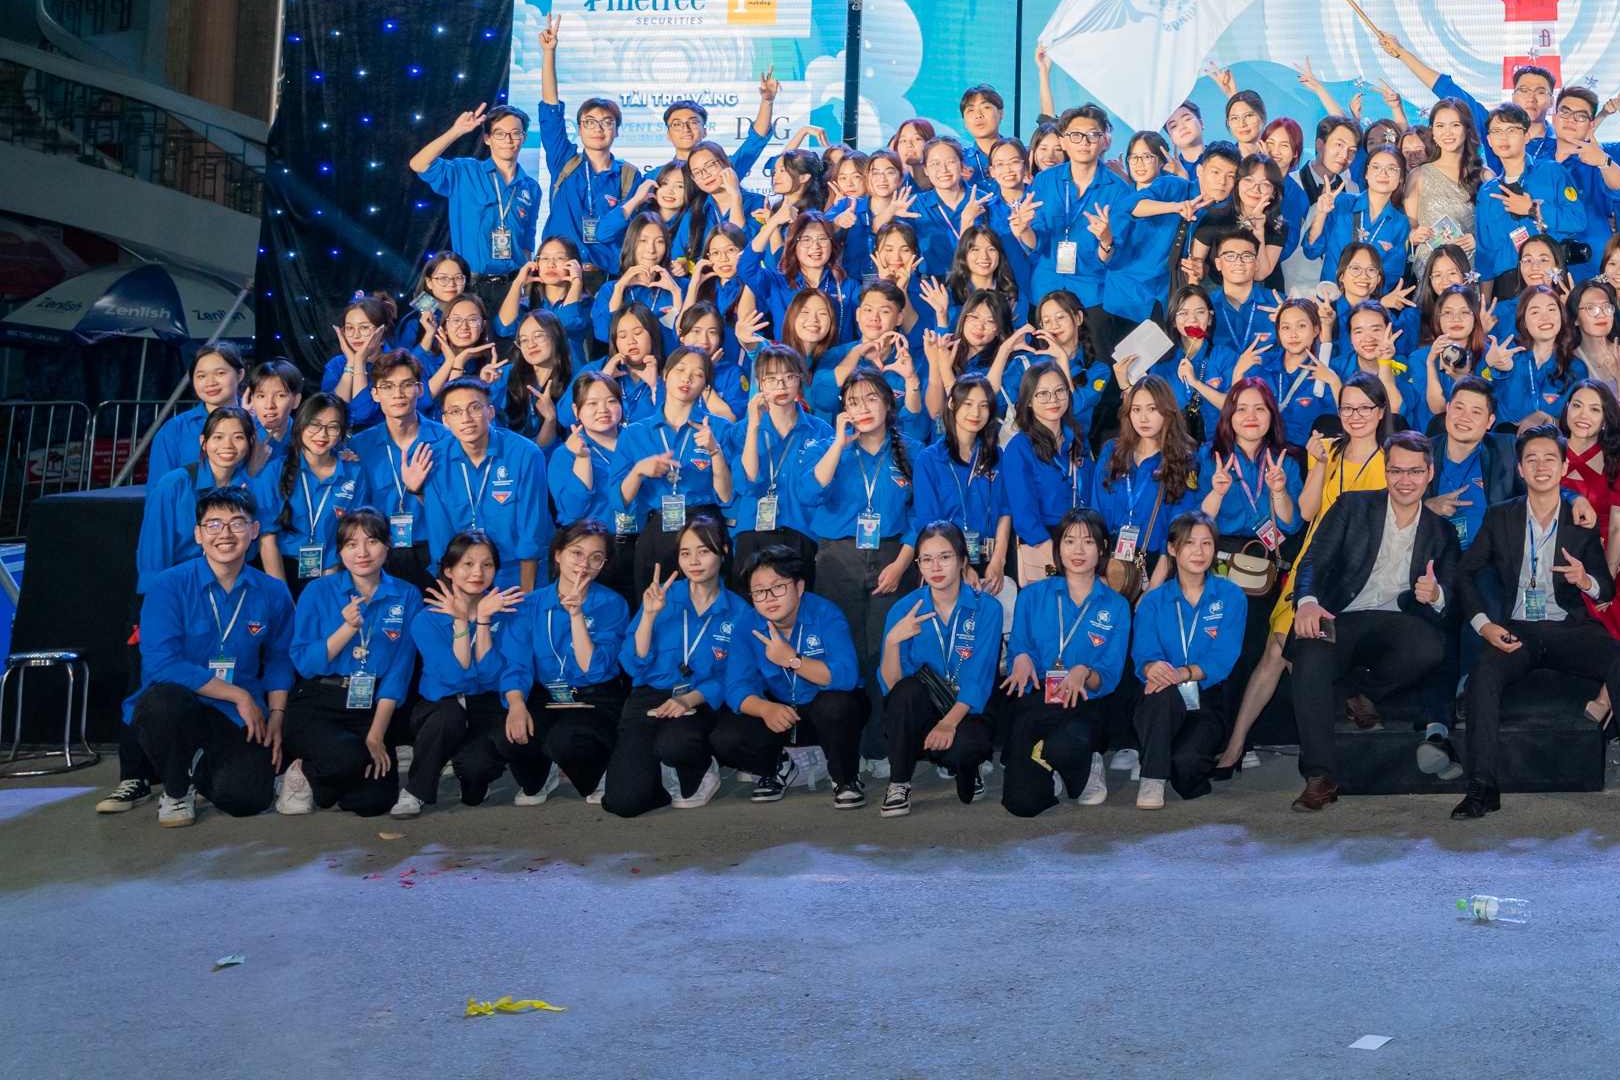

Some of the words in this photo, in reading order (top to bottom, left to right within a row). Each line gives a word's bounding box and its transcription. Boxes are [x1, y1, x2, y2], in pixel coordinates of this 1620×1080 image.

[636, 17, 703, 25] SECURITIES
[620, 90, 647, 107] TÀI
[691, 90, 738, 107] VÀNG
[104, 305, 171, 319] Zenlish
